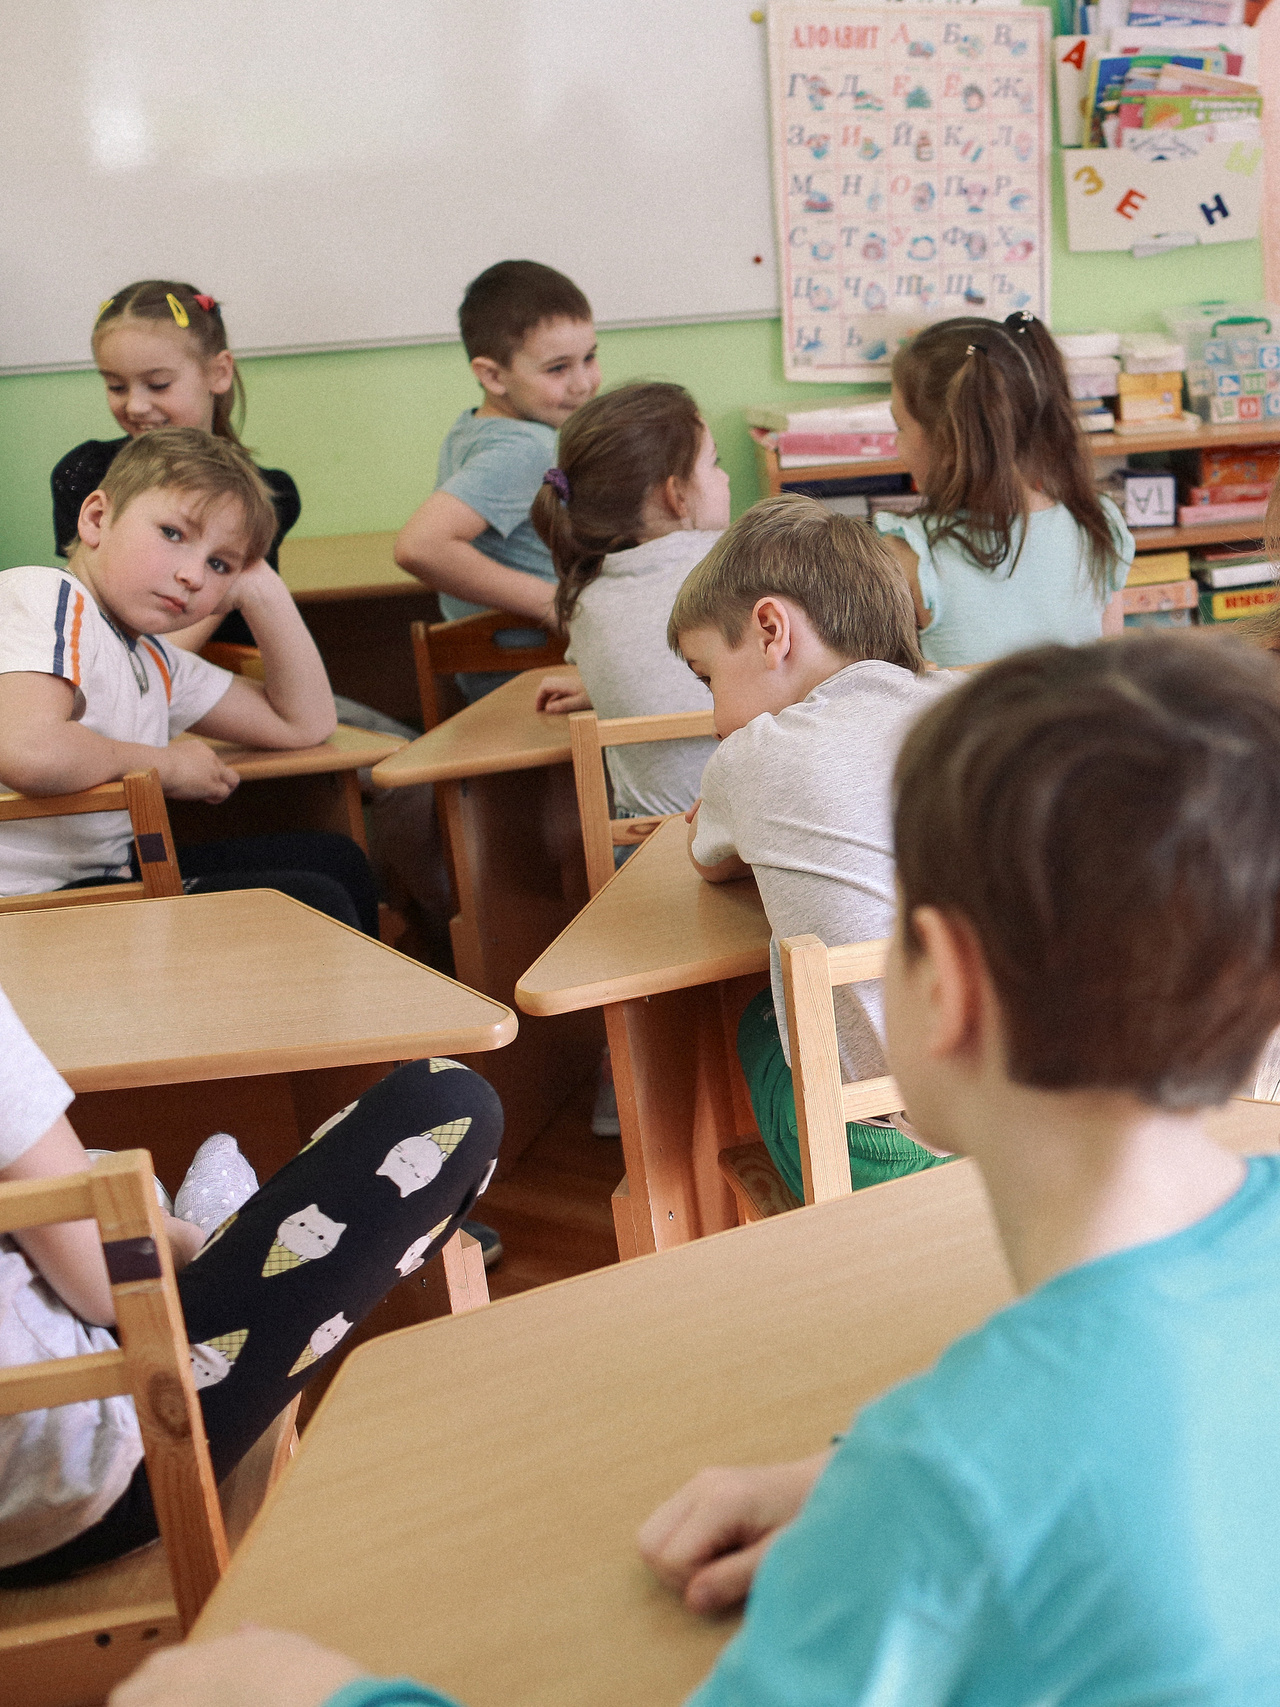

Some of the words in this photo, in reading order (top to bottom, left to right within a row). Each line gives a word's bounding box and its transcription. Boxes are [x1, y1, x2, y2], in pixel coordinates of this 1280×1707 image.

[943, 23, 961, 44] Б
[994, 23, 1012, 46] В
[1115, 189, 1147, 220] Е
[1200, 193, 1229, 225] Н
